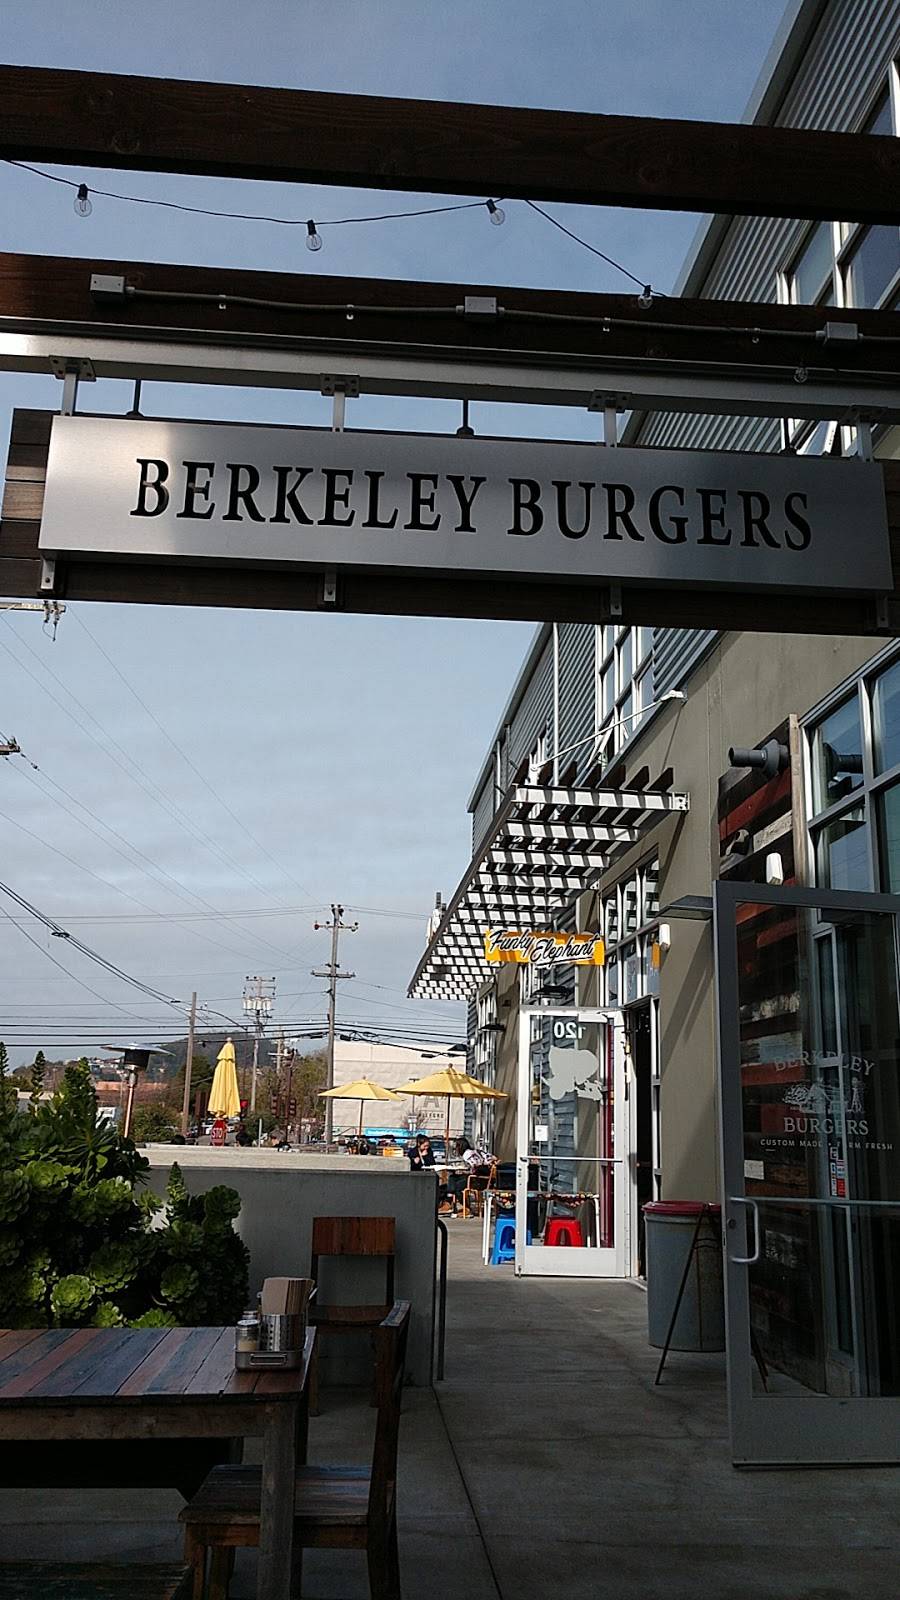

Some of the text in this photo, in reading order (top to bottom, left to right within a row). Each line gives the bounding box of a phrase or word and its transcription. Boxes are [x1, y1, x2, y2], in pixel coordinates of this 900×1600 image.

[130, 458, 811, 551] BERKELEY BURGERS
[489, 928, 601, 966] Funky Elephant
[783, 1117, 869, 1136] BURGERS
[760, 1138, 893, 1151] CUSTOM MADE FRM FRESH
